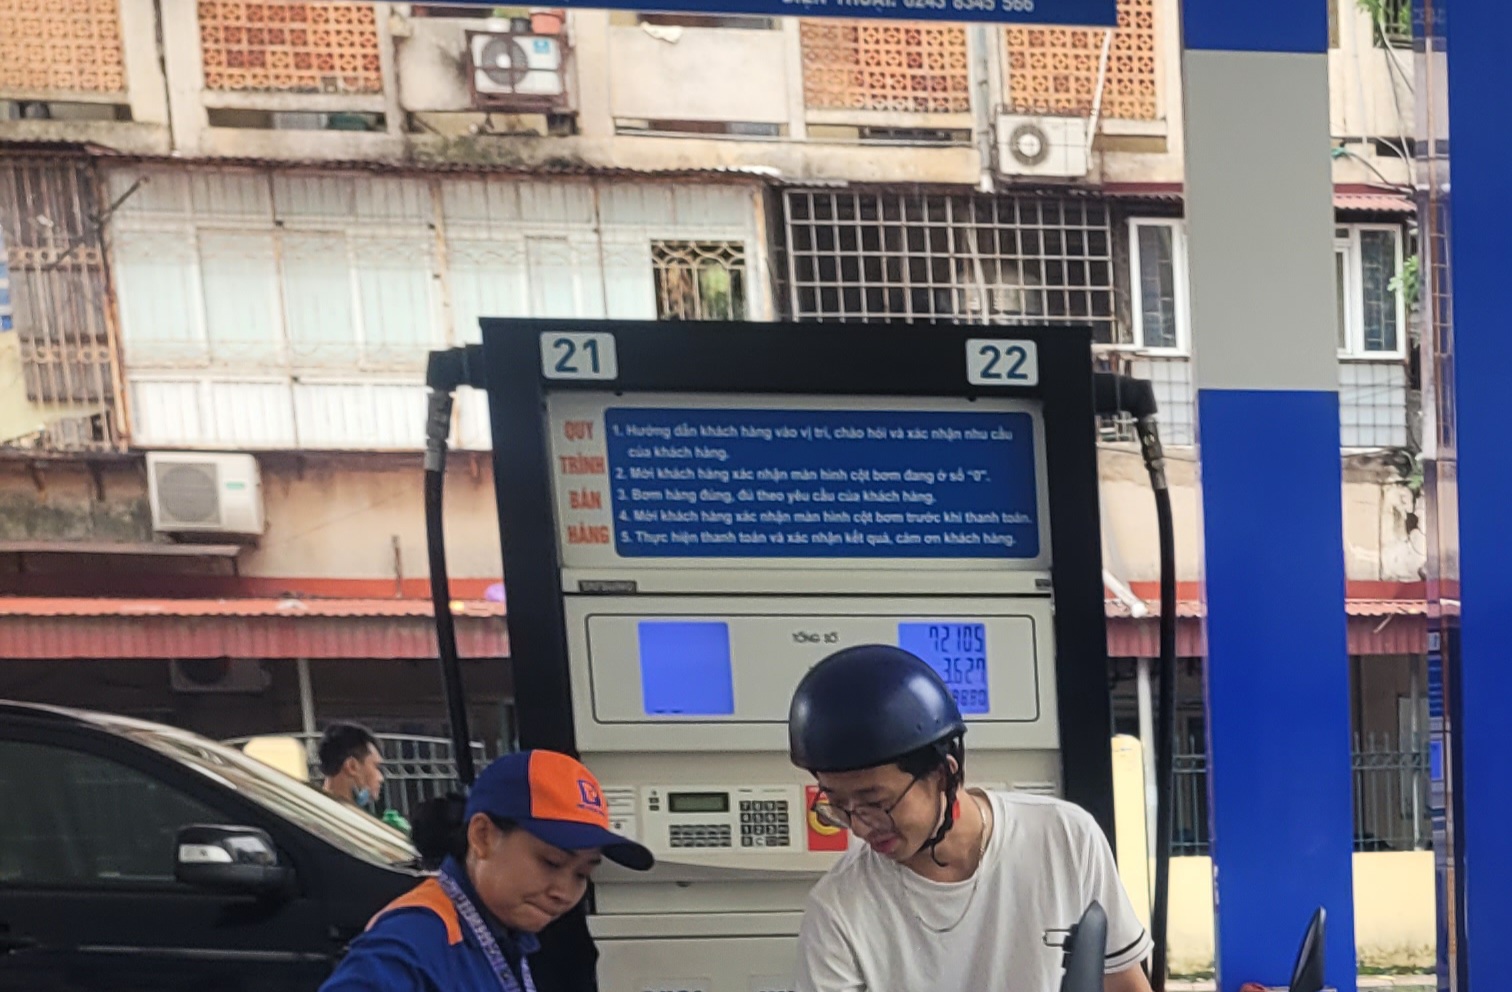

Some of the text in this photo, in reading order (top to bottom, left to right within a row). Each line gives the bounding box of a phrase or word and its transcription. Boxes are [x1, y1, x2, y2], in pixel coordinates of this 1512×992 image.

[554, 339, 600, 373] 21
[979, 345, 1028, 380] 22
[929, 626, 983, 652] 72105
